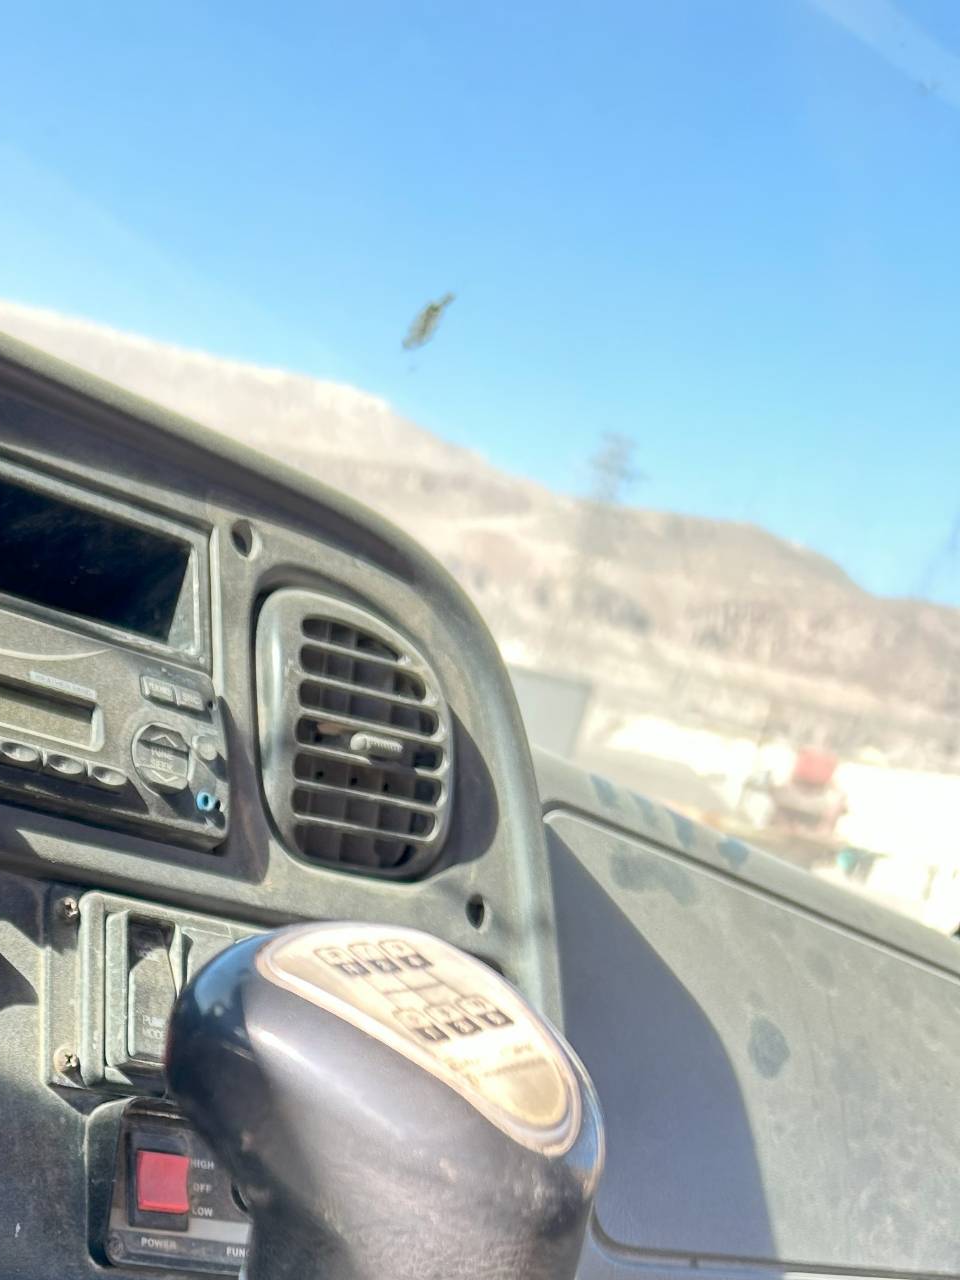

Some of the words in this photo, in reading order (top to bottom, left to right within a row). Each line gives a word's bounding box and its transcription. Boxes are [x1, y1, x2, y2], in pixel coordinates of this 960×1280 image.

[192, 1182, 213, 1194] OFF
[191, 1205, 214, 1218] LOW
[140, 1236, 177, 1251] POWER
